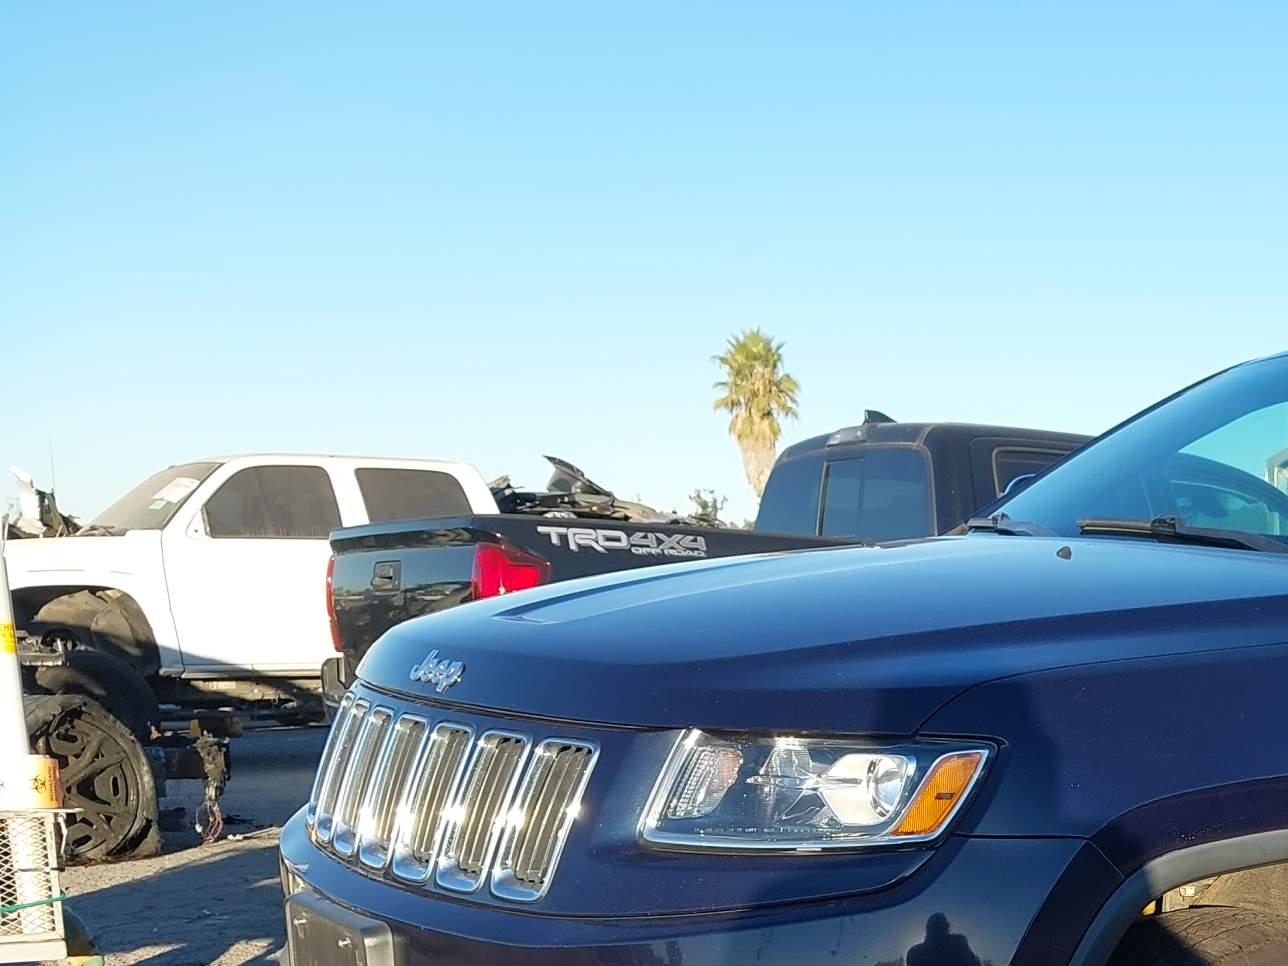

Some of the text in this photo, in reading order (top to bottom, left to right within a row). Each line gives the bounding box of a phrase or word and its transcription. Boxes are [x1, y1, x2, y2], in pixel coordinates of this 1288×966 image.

[536, 525, 631, 553] TRD
[631, 547, 706, 558] OFF ROAD
[409, 648, 464, 693] Jeep
